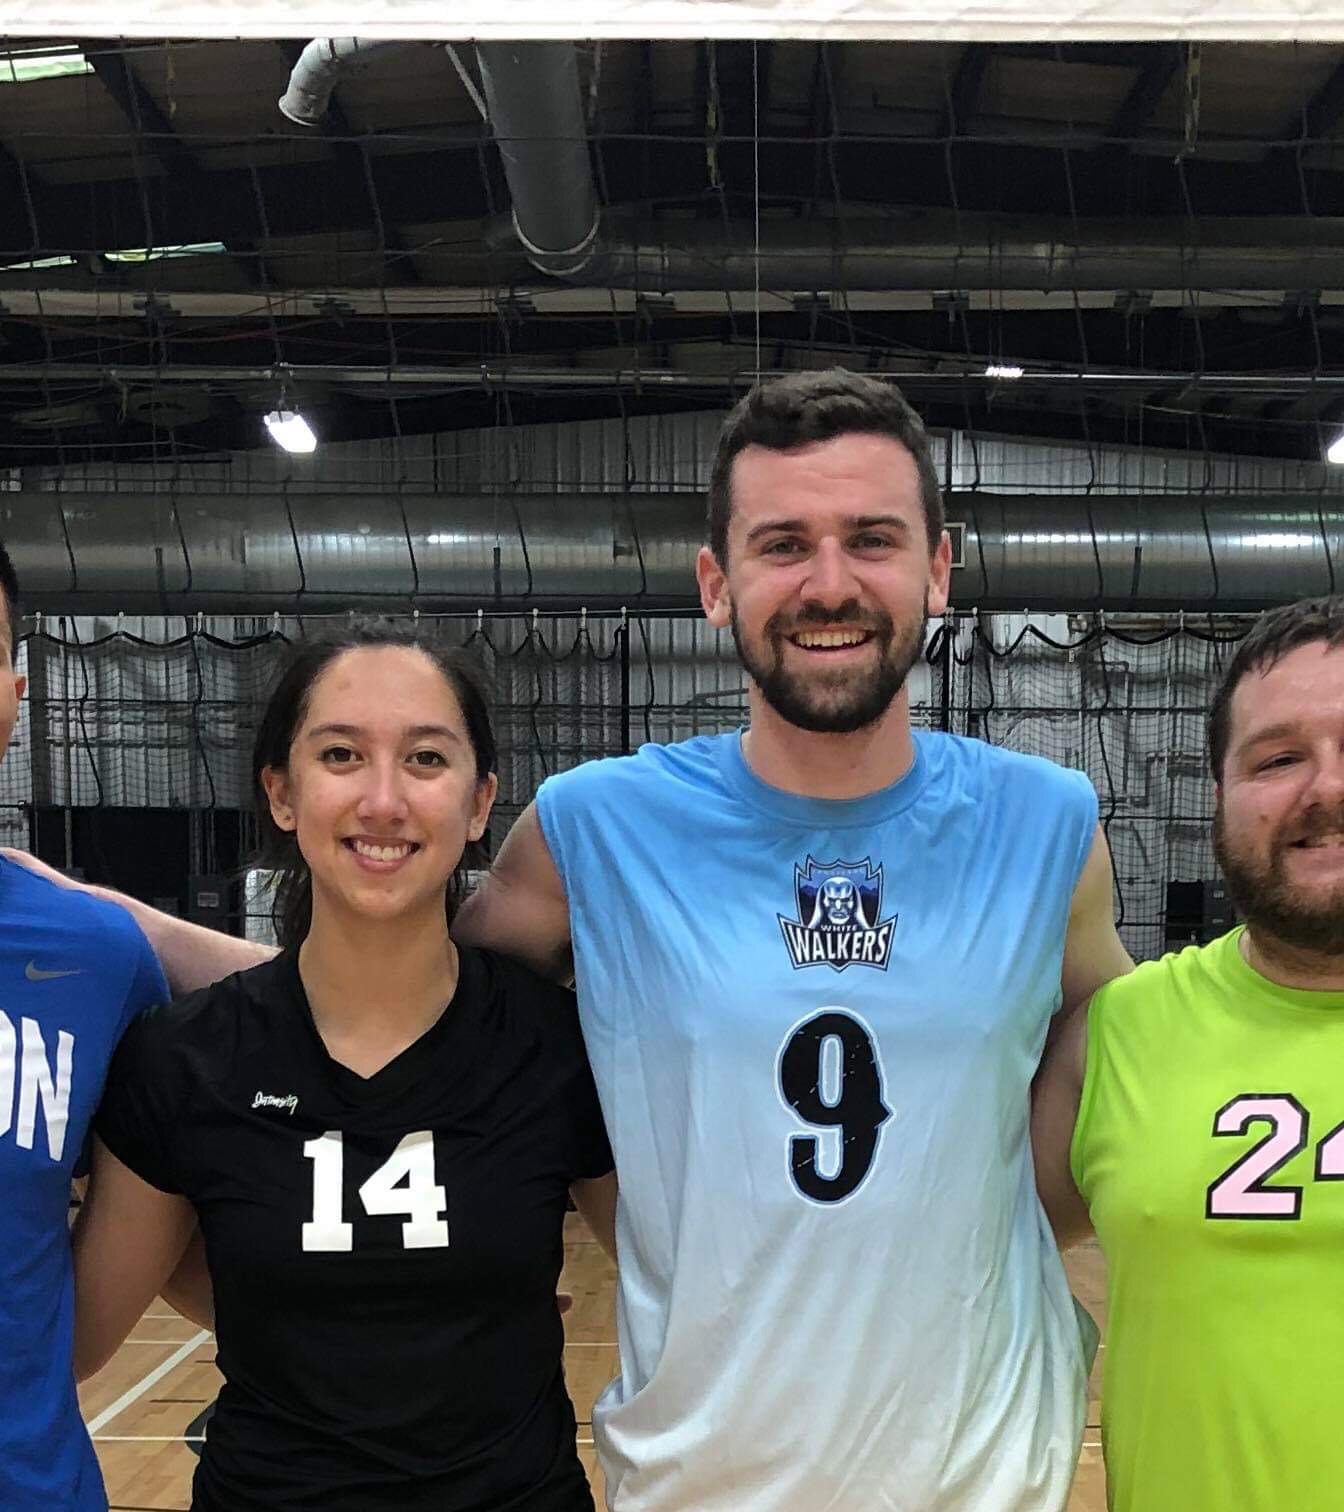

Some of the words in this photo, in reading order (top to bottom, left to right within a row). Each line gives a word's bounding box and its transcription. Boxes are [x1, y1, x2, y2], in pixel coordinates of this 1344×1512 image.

[787, 923, 889, 963] WALKERS
[775, 1005, 897, 1209] 9
[302, 1130, 449, 1252] 14
